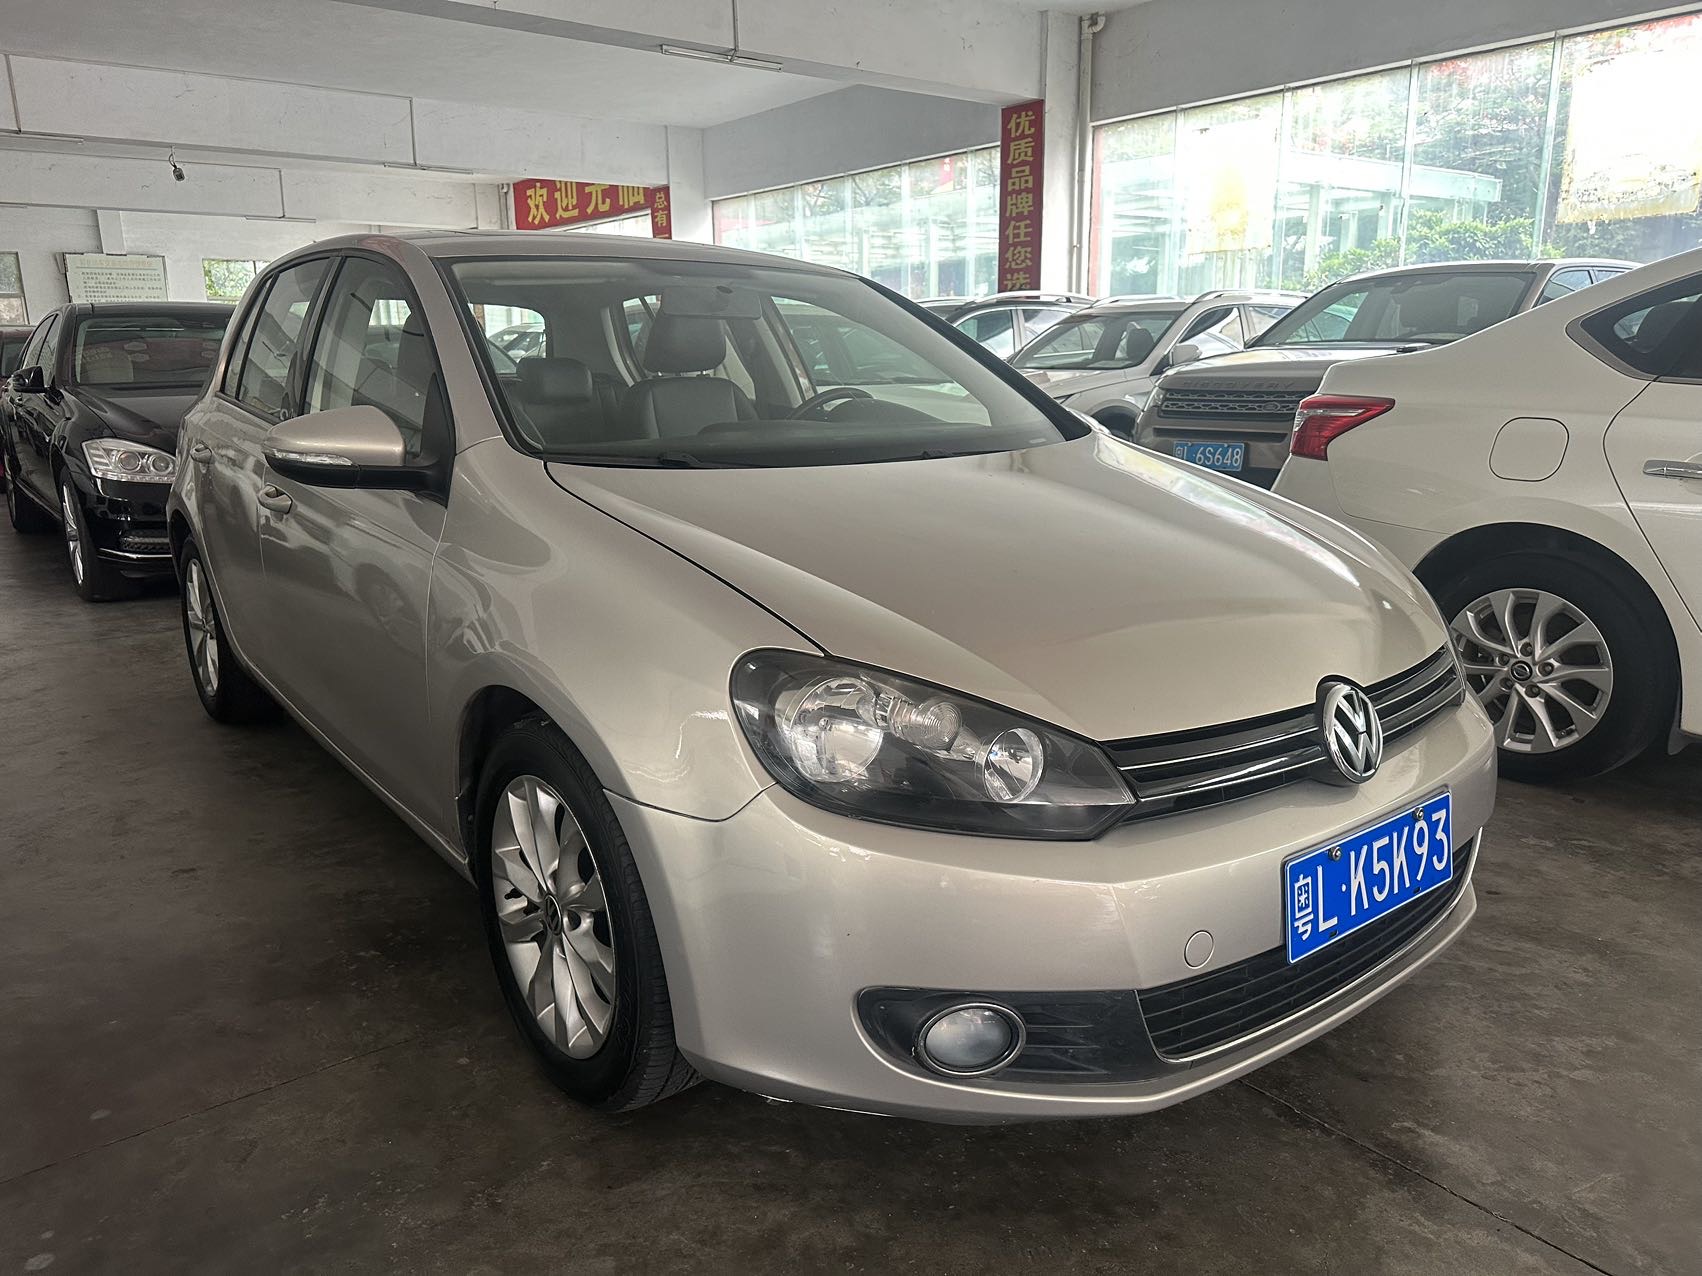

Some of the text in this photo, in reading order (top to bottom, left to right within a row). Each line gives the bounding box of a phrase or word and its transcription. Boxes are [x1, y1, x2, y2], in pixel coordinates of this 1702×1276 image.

[1004, 111, 1035, 289] 优质品牌任您选
